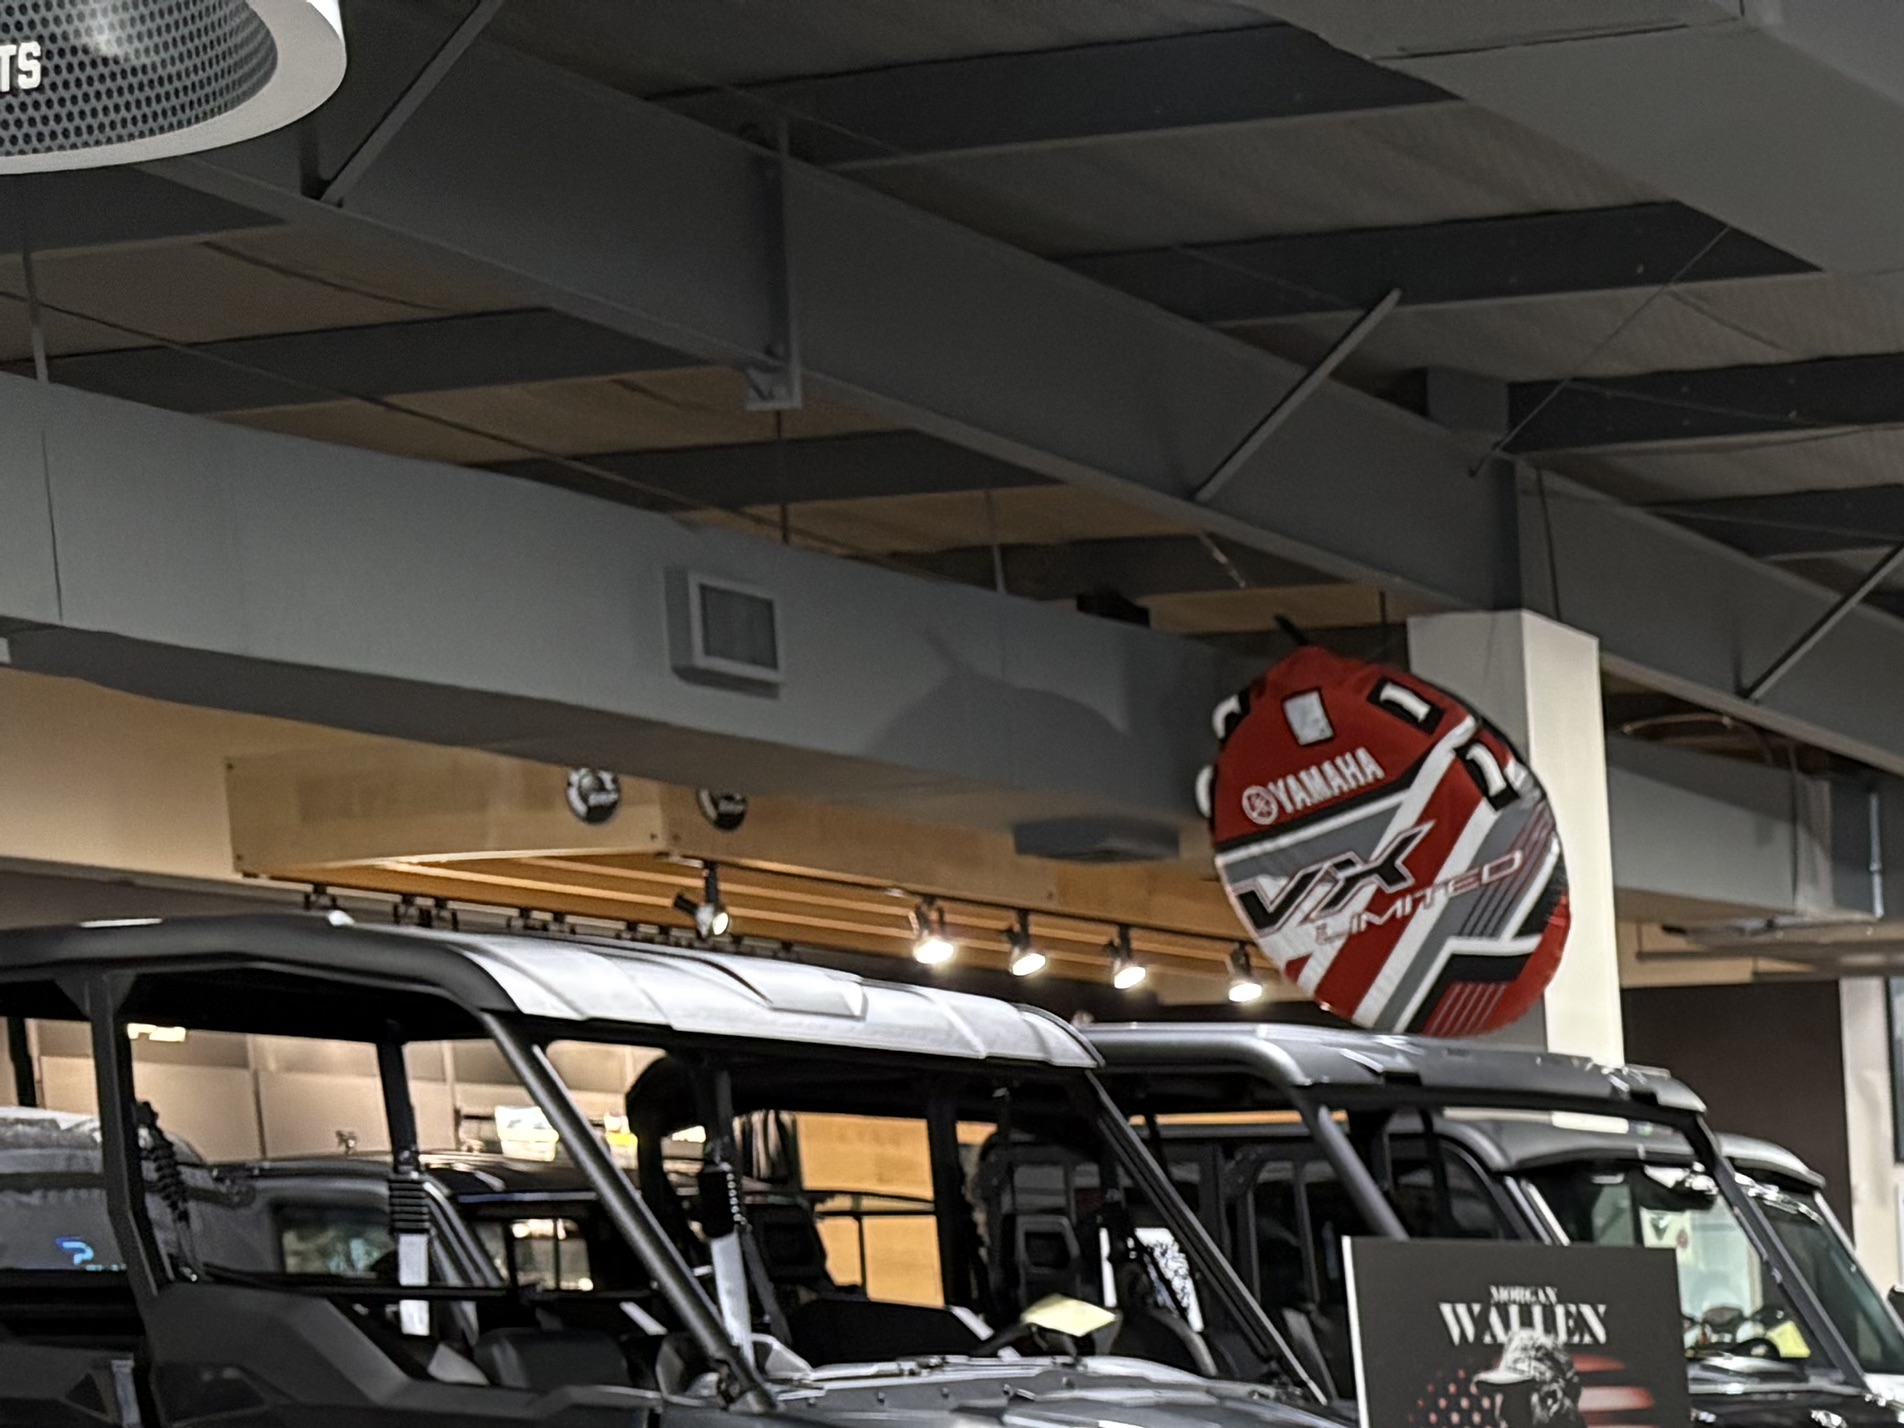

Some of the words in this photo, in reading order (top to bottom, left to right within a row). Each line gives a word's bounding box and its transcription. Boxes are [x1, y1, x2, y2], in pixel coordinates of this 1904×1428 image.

[1270, 748, 1385, 814] YAMAHA
[1236, 820, 1434, 935] VX
[1315, 849, 1525, 947] LIMITED
[1489, 1285, 1558, 1304] MORGAN
